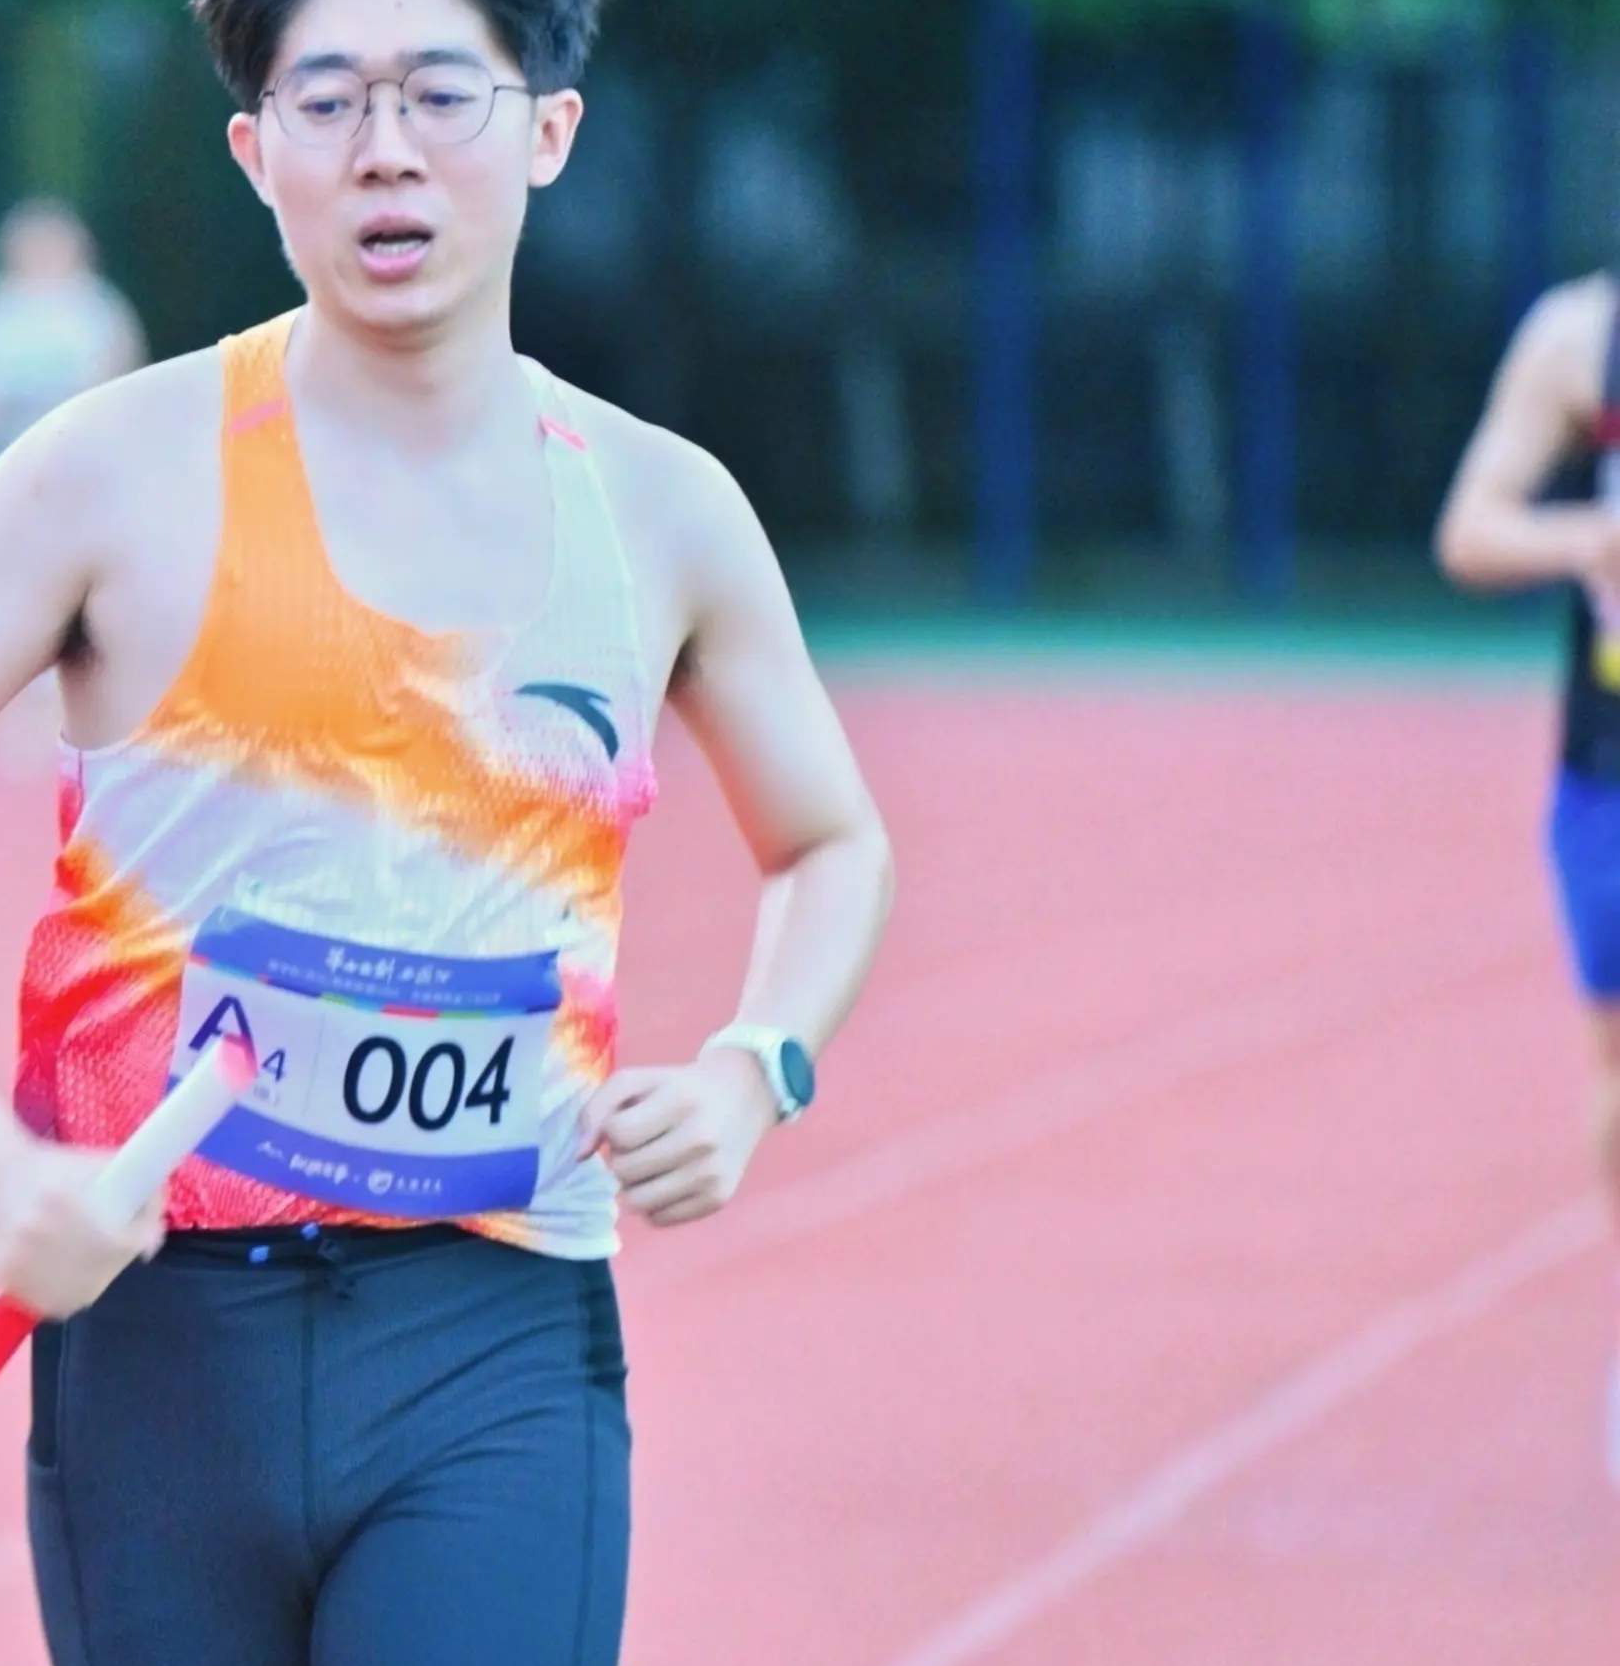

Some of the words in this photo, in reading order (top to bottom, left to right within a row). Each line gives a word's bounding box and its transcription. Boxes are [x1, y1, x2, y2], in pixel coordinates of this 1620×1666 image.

[188, 994, 258, 1078] A
[261, 1047, 286, 1082] 4
[342, 1035, 515, 1131] 004
